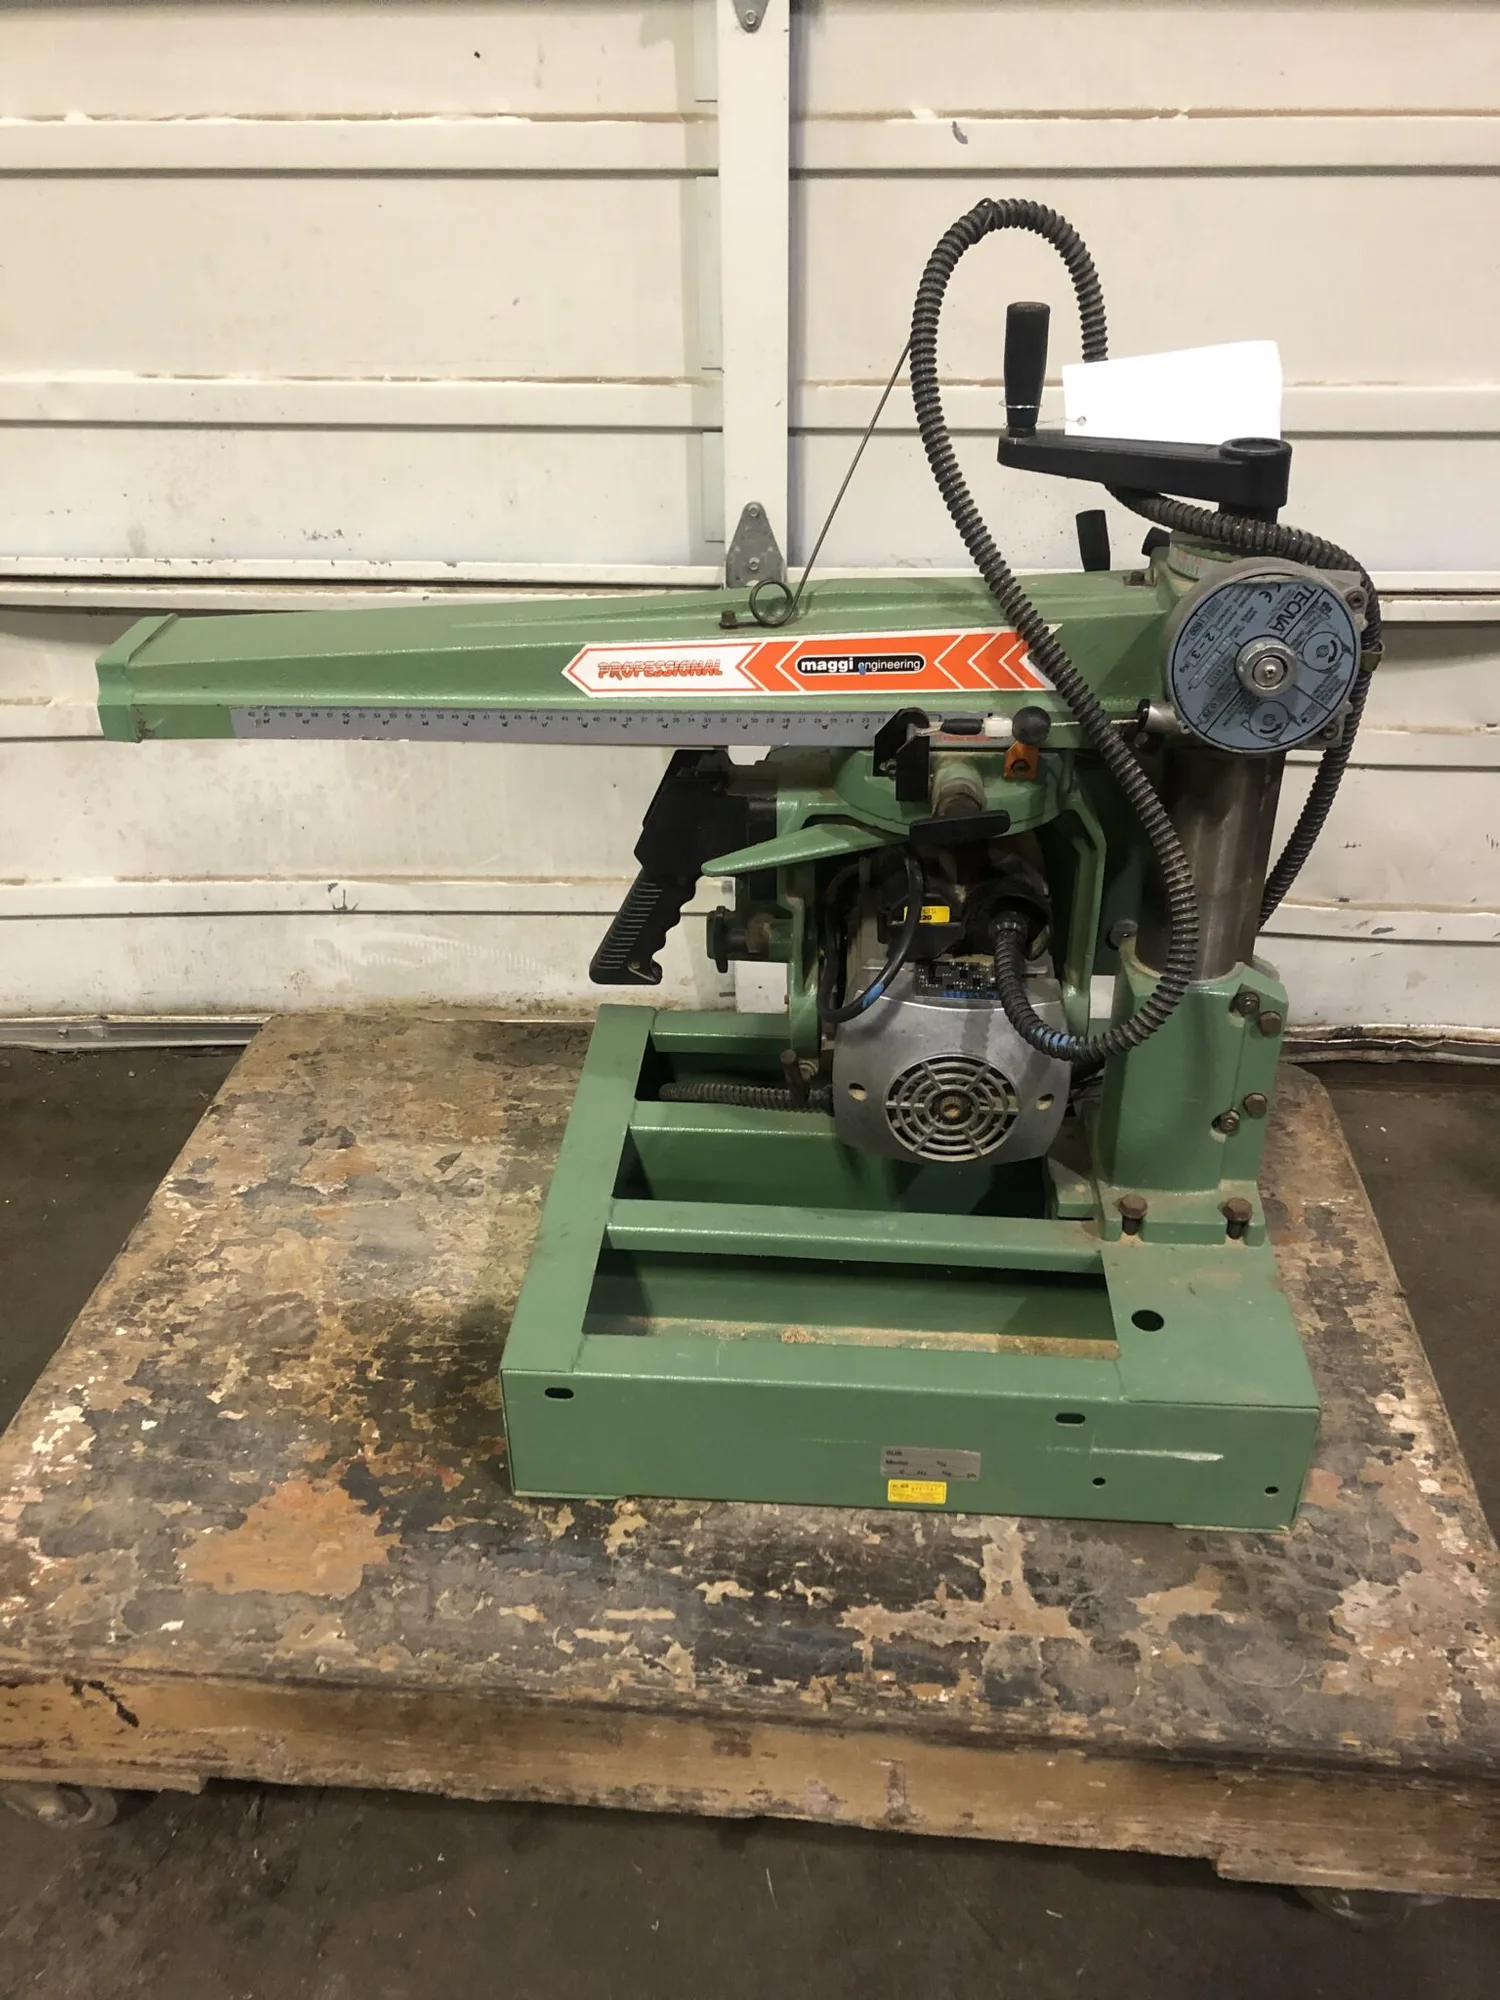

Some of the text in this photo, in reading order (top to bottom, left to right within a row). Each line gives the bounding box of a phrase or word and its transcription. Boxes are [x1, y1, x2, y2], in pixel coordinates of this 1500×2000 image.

[1269, 586, 1317, 632] TECNA
[598, 659, 723, 681] PROFESSIONAL
[801, 657, 920, 672] maggi engineering
